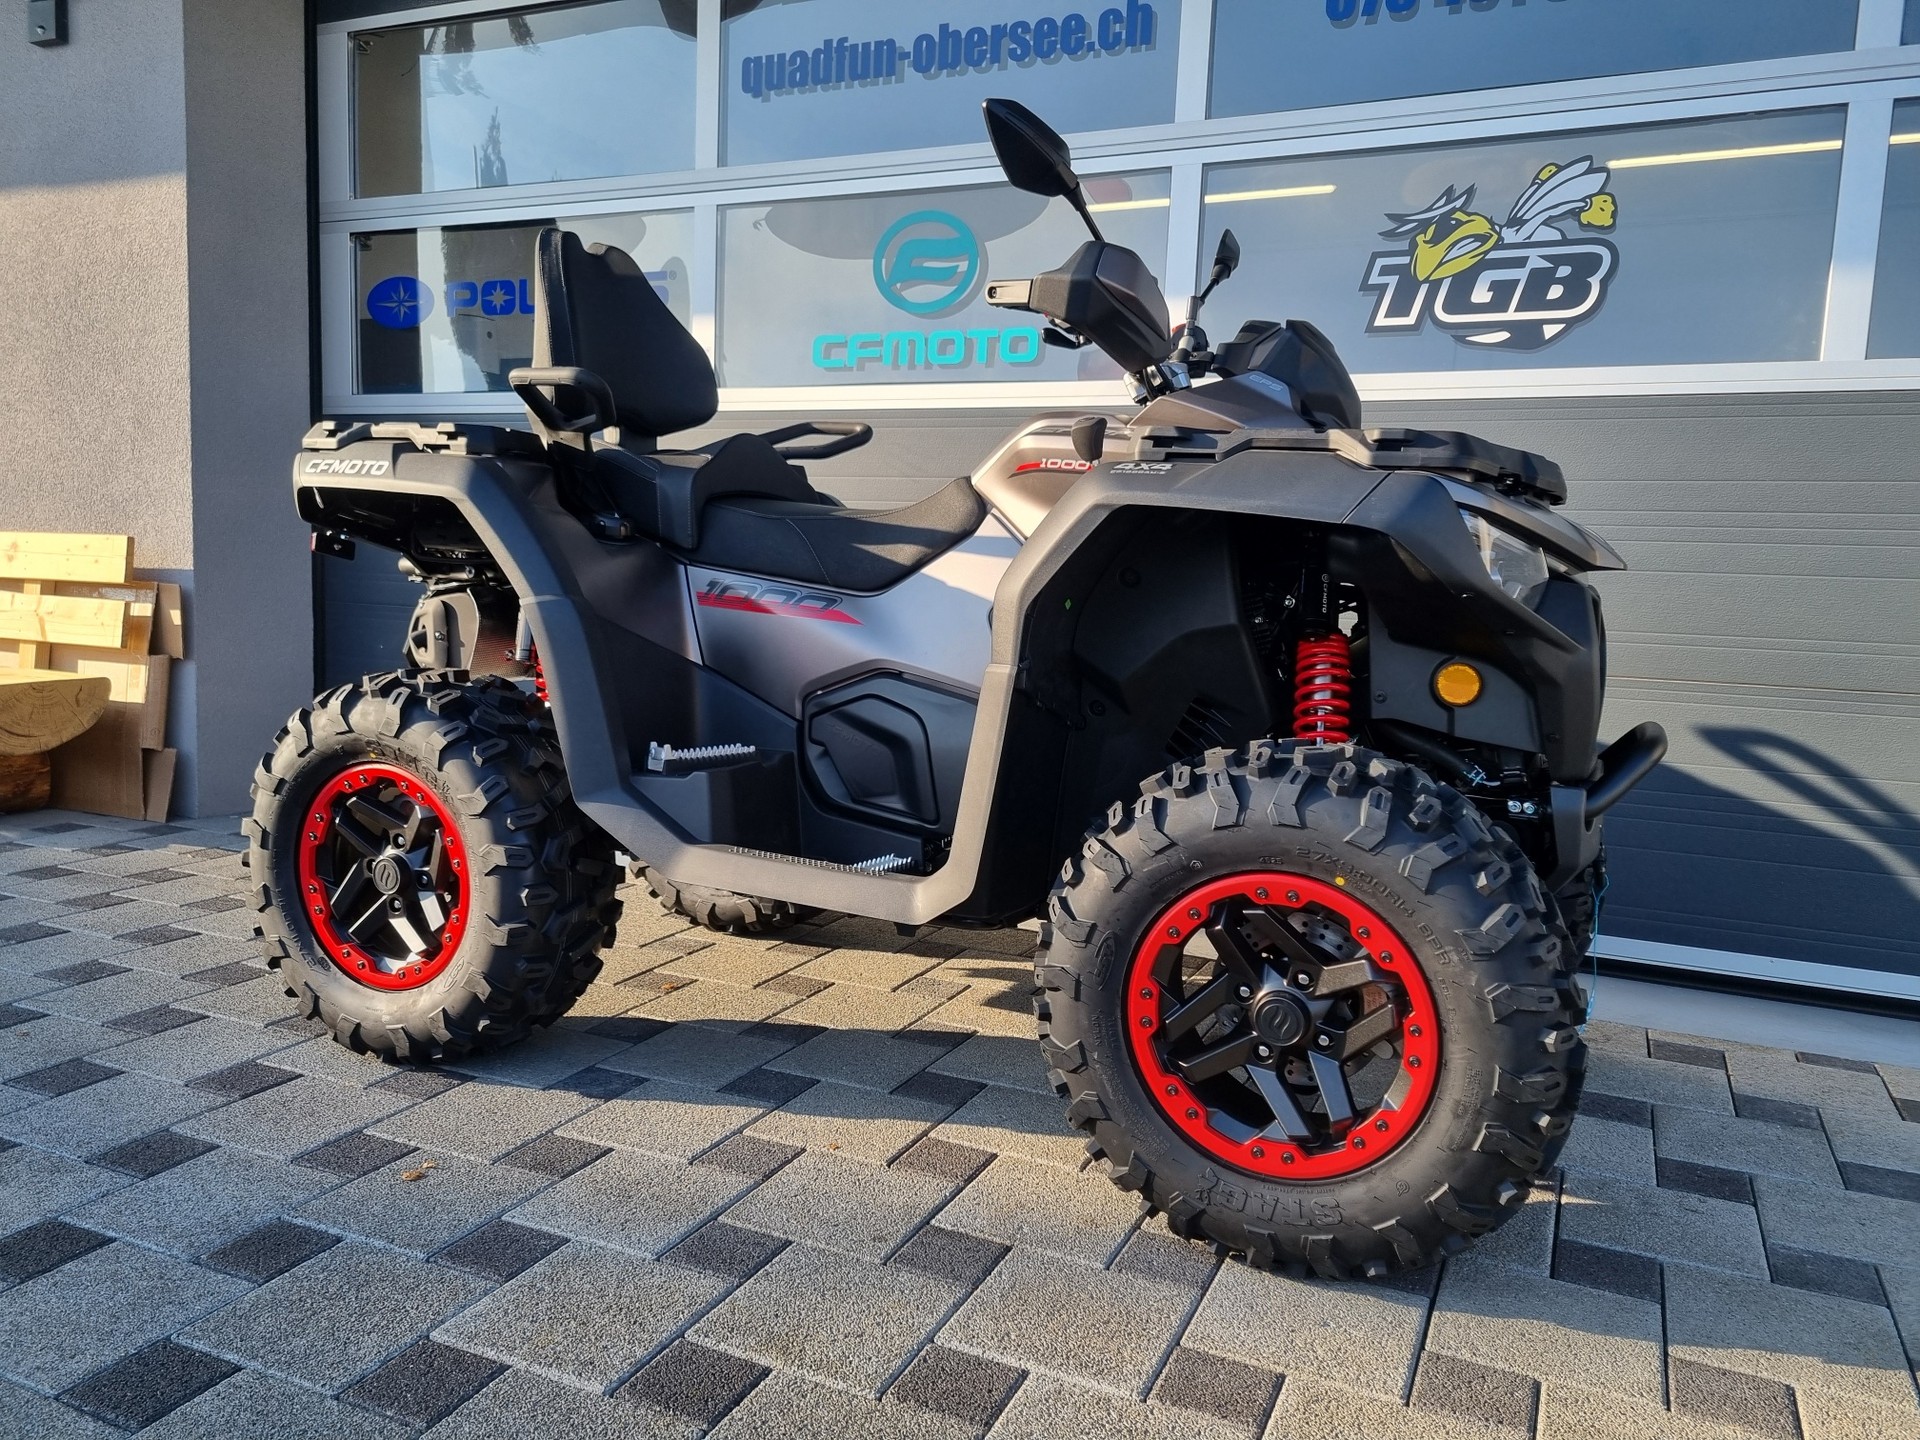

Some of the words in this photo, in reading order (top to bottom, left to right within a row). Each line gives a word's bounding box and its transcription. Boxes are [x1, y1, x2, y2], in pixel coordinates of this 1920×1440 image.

[741, 0, 1154, 98] quadfun-obersee.ch
[1364, 240, 1616, 329] TGB
[811, 326, 1040, 369] CFMOTO
[1249, 374, 1284, 392] EPS
[305, 459, 390, 476] CFMOTO
[703, 577, 843, 612] 1000
